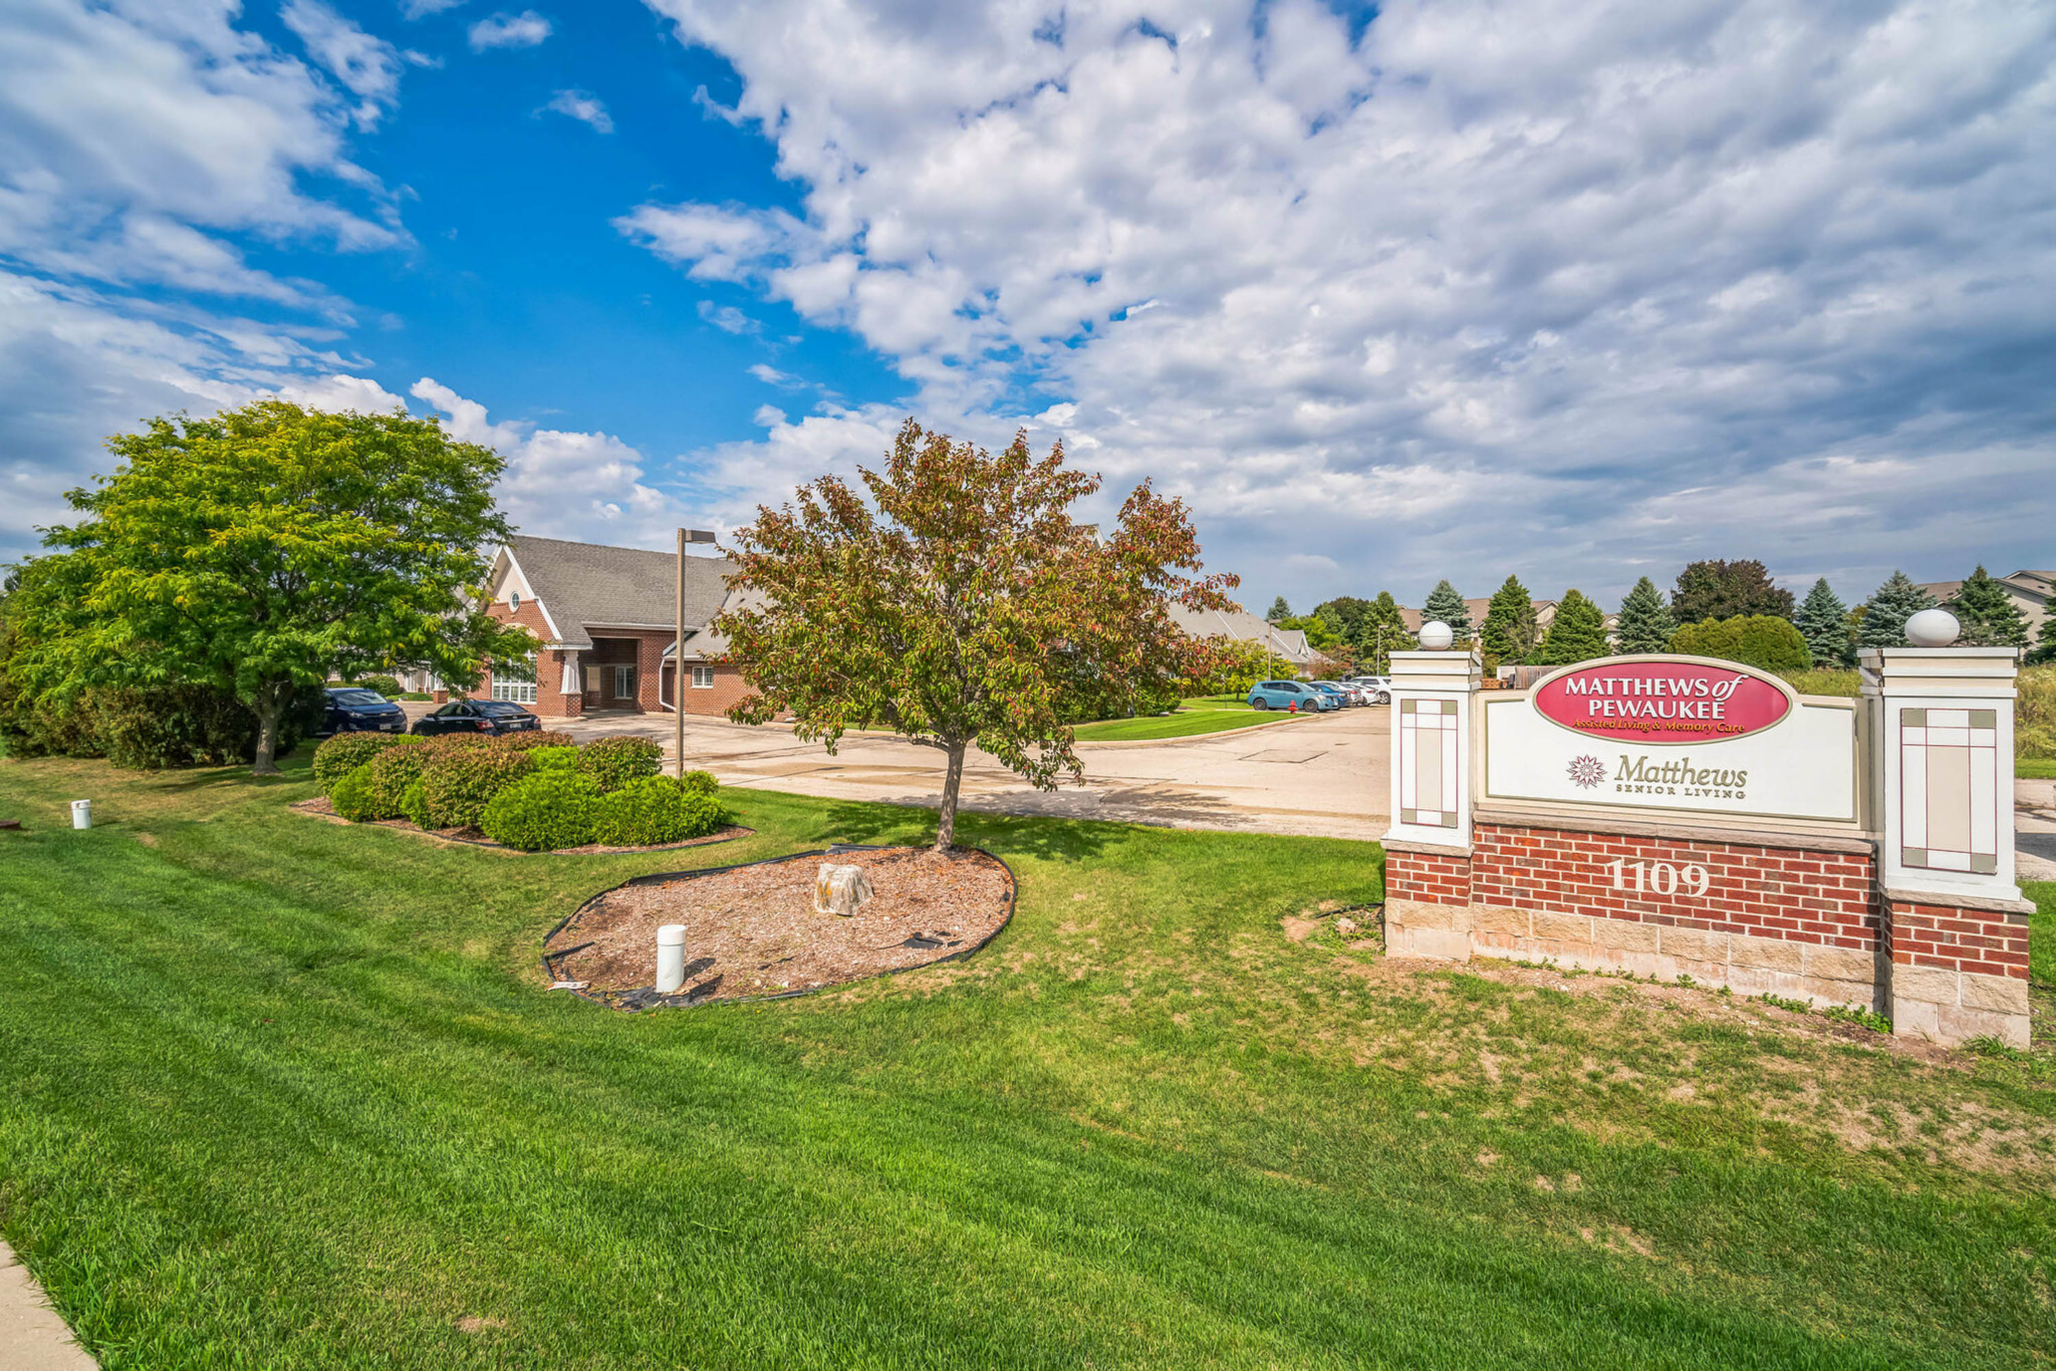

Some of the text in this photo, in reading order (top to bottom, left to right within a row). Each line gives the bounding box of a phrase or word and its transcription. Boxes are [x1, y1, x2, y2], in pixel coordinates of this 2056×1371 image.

[1565, 674, 1749, 702] MATTHEWS of
[1588, 699, 1726, 720] PEWAUKEE
[1572, 718, 1746, 735] Assisted Living & Memory Care
[1614, 754, 1748, 788] Matthews
[1616, 784, 1747, 800] SENIOR LIVING
[1605, 859, 1710, 898] 1109
